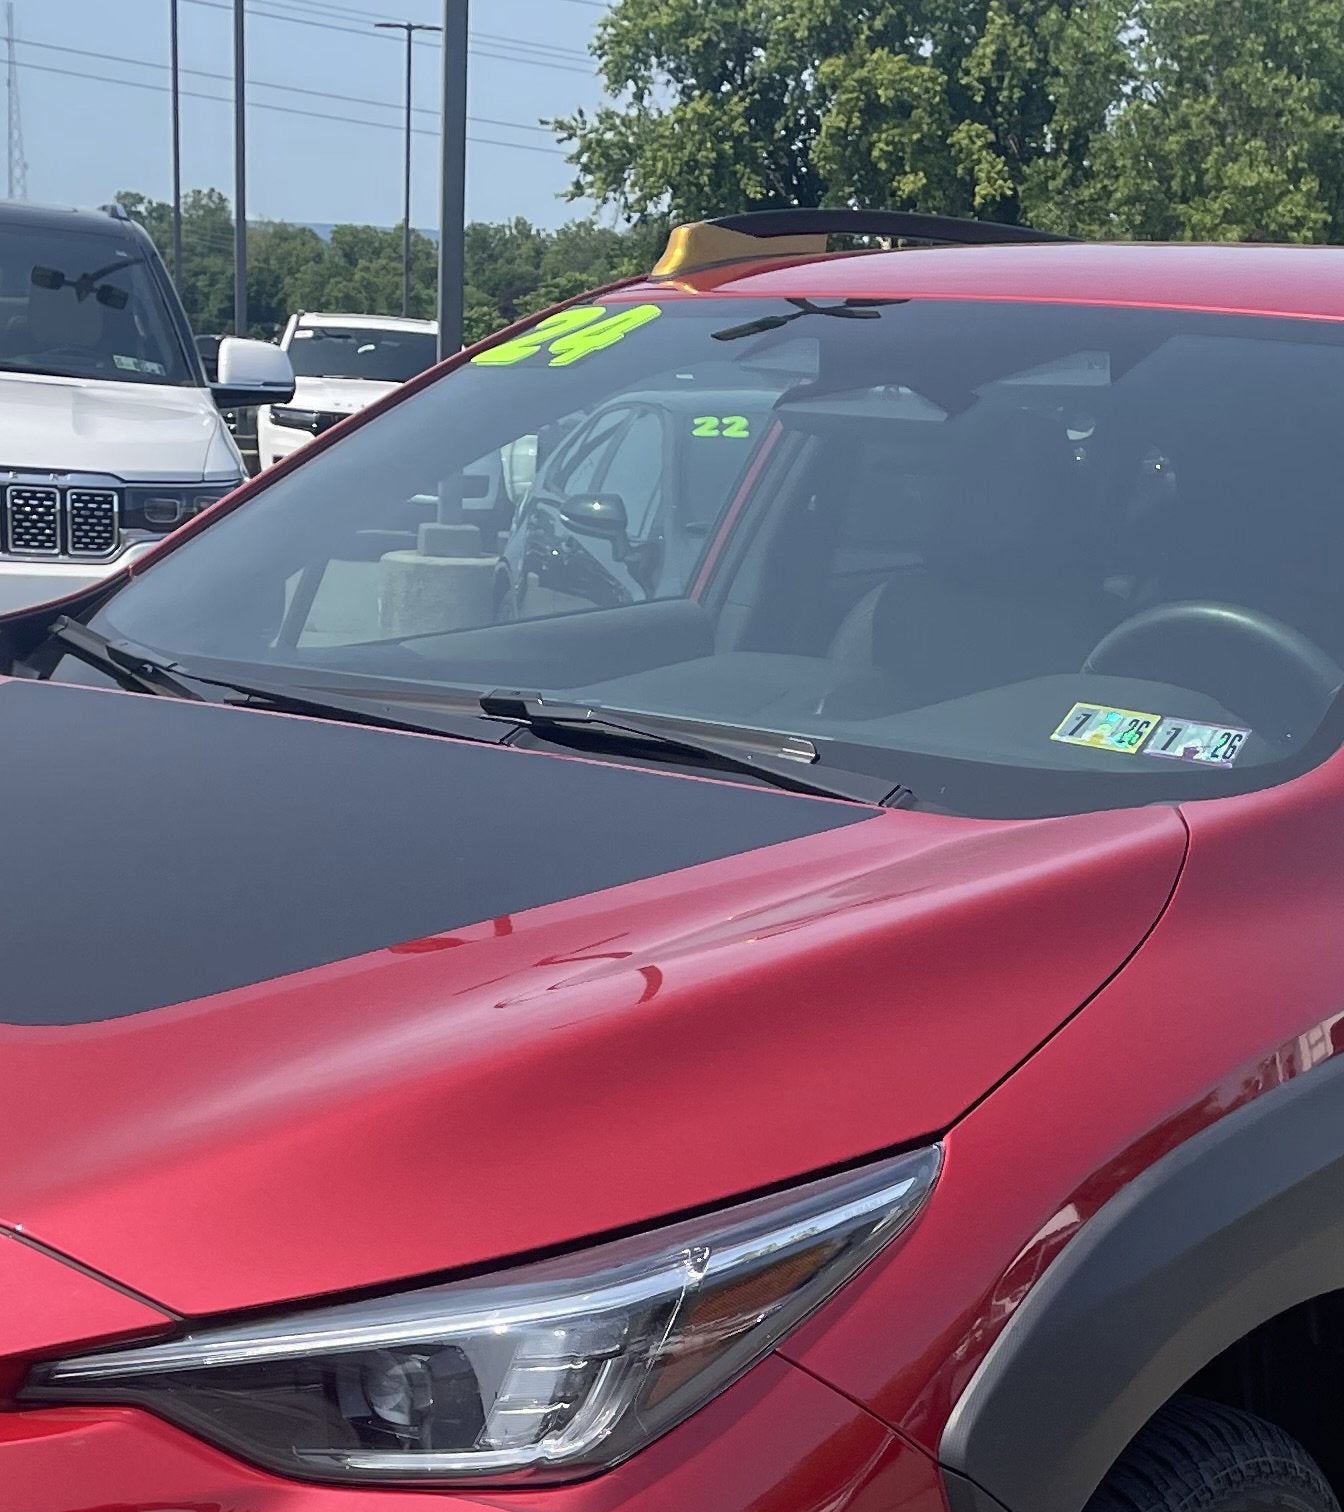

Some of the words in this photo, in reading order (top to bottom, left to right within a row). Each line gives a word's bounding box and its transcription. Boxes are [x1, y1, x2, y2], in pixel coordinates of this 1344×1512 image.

[471, 304, 662, 366] 24
[692, 415, 749, 438] 22
[1209, 731, 1244, 761] 26
